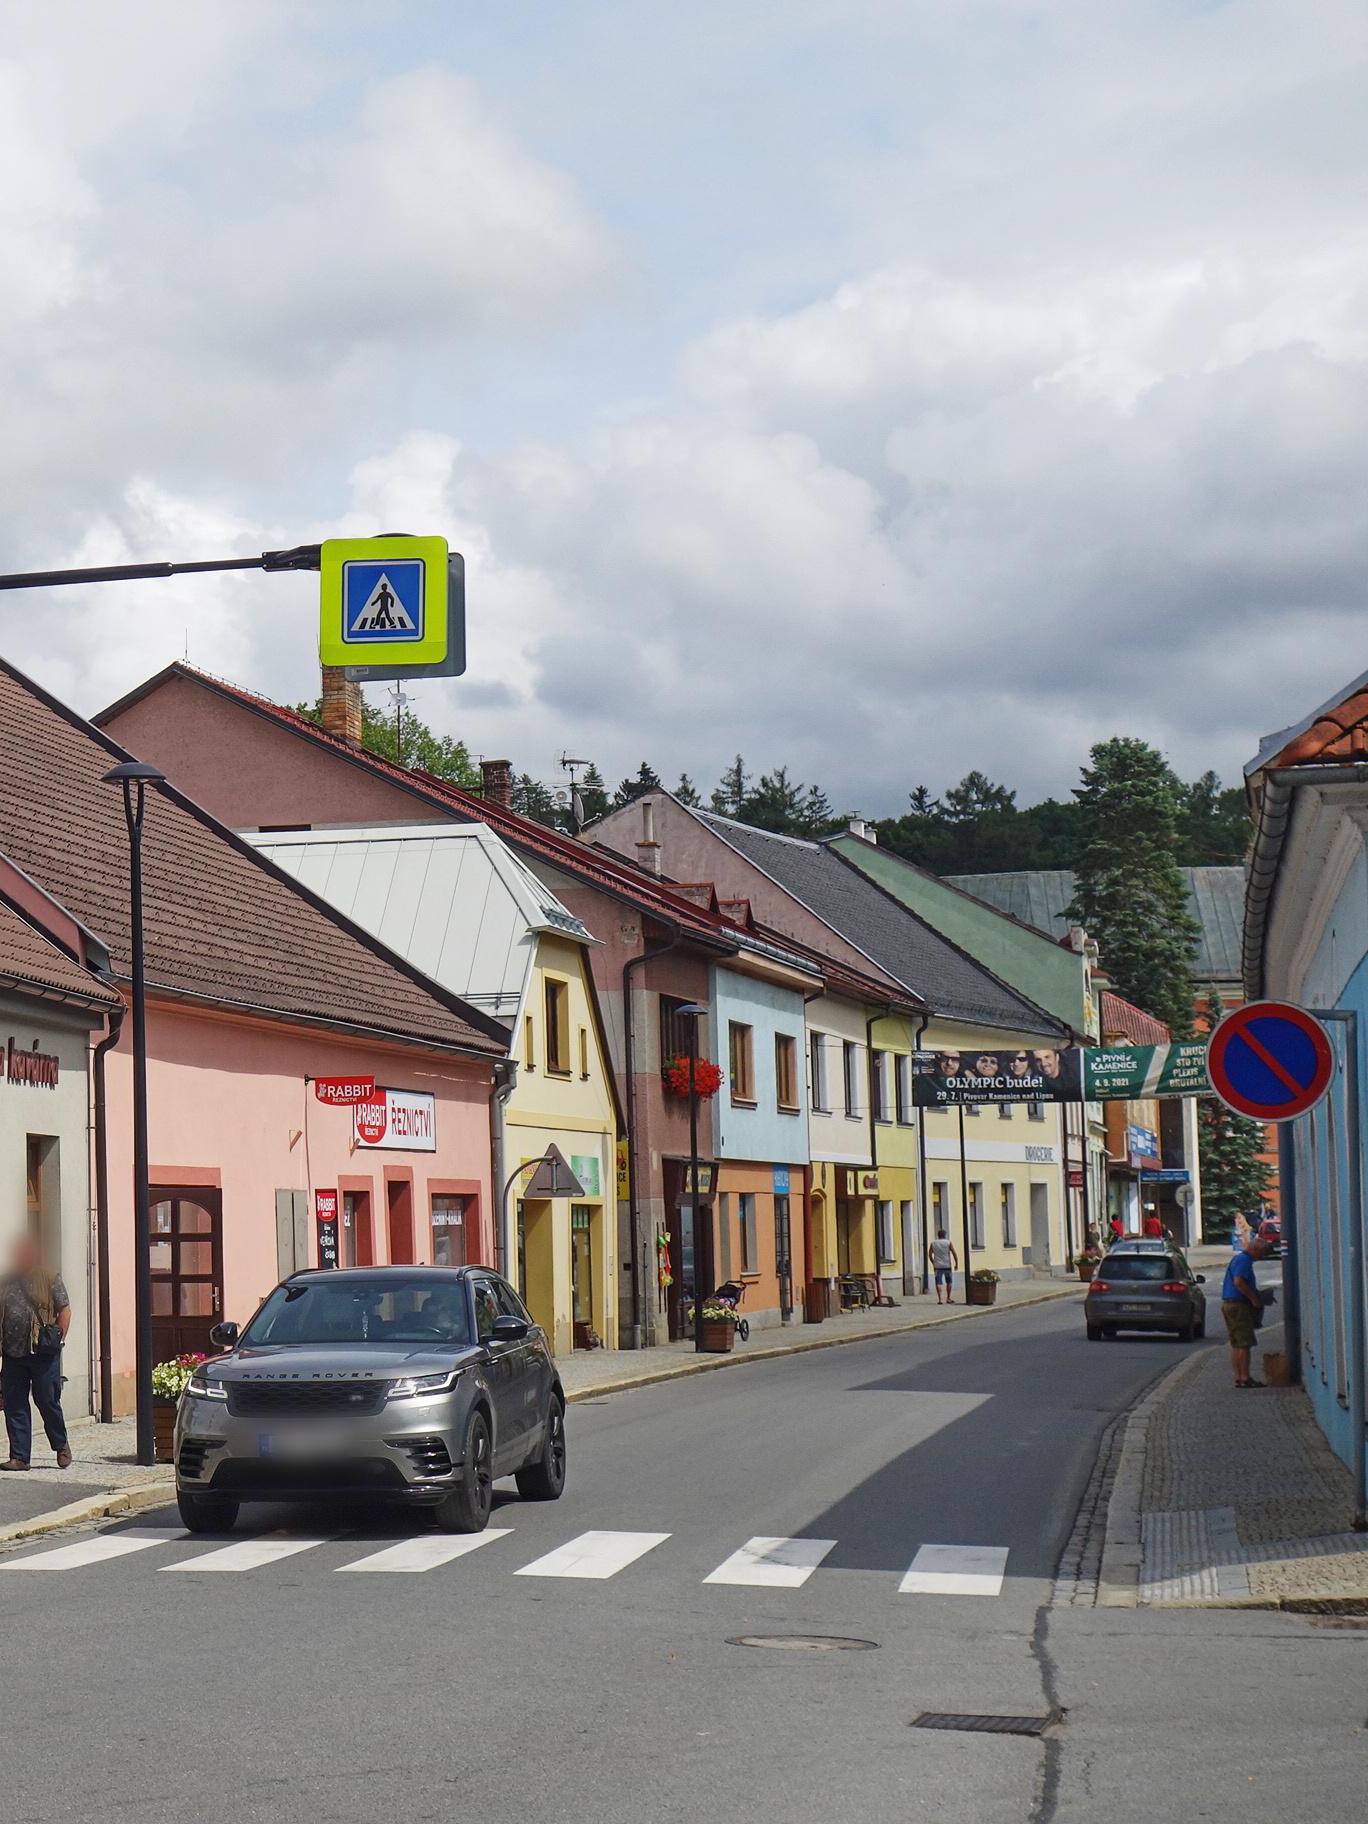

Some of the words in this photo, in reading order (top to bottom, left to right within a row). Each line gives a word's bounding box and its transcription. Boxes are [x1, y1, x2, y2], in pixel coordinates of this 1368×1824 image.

[8, 1036, 60, 1085] kavárna
[1090, 1061, 1138, 1071] KAMENICE
[1193, 1056, 1205, 1066] ZVÍ
[946, 1077, 1004, 1089] OLYMPIC
[1006, 1076, 1043, 1088] bude!
[1112, 1078, 1129, 1087] 2021
[327, 1084, 372, 1098] RABBIT
[362, 1103, 387, 1127] RABBIT
[392, 1099, 432, 1138] ŘEZNICTVÍ
[1024, 1145, 1054, 1162] DROGERIE
